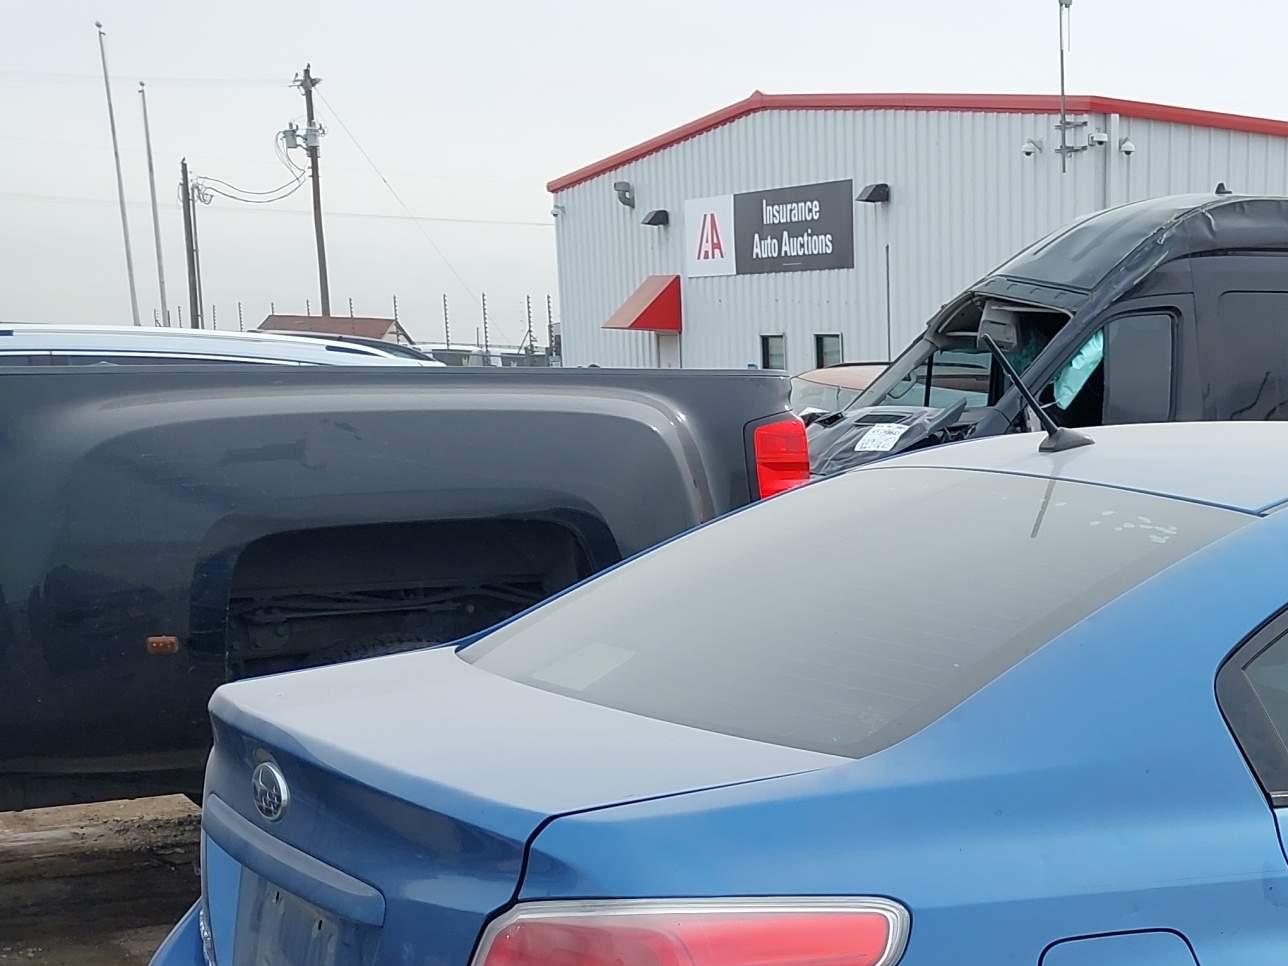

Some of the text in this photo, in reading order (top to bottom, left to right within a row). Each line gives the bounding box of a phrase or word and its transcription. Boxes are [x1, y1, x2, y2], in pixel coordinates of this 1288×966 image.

[762, 199, 820, 225] Insurance
[752, 229, 833, 259] Auto Auctions
